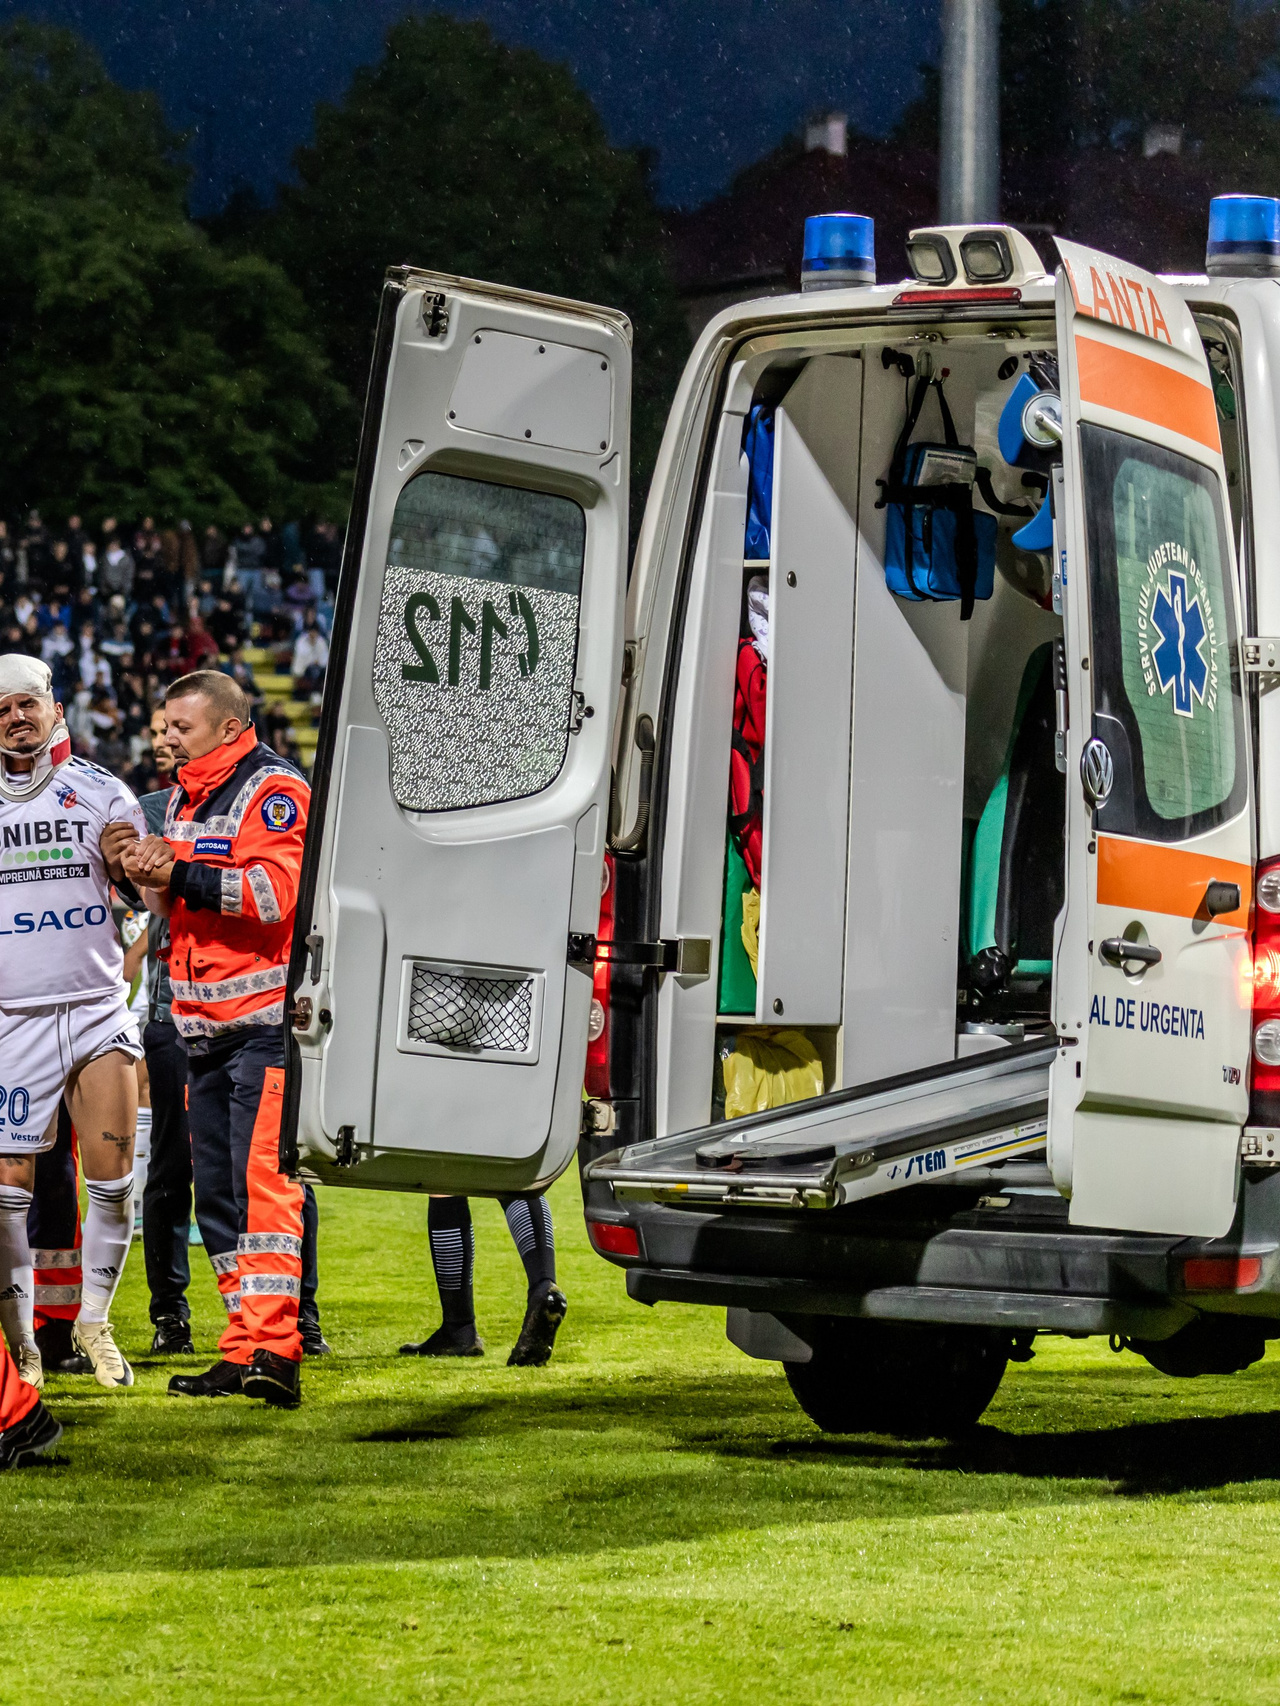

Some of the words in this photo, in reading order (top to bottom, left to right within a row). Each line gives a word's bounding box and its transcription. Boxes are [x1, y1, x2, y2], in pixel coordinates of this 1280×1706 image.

[1064, 258, 1172, 346] LANTA
[1137, 584, 1157, 697] SERVICIUL
[1147, 542, 1189, 584] JUDETEAN
[1189, 558, 1202, 585] DE
[1199, 589, 1219, 713] AMBULANTA
[196, 842, 229, 851] BOTOSANI
[43, 867, 68, 880] SPRE
[68, 865, 85, 878] 0%
[1089, 994, 1111, 1027] AL
[1114, 997, 1136, 1030] DE
[1140, 1001, 1205, 1040] URGENTA
[1222, 1064, 1241, 1086] TDI
[11, 1132, 40, 1142] Vestra
[905, 1149, 947, 1179] STEM
